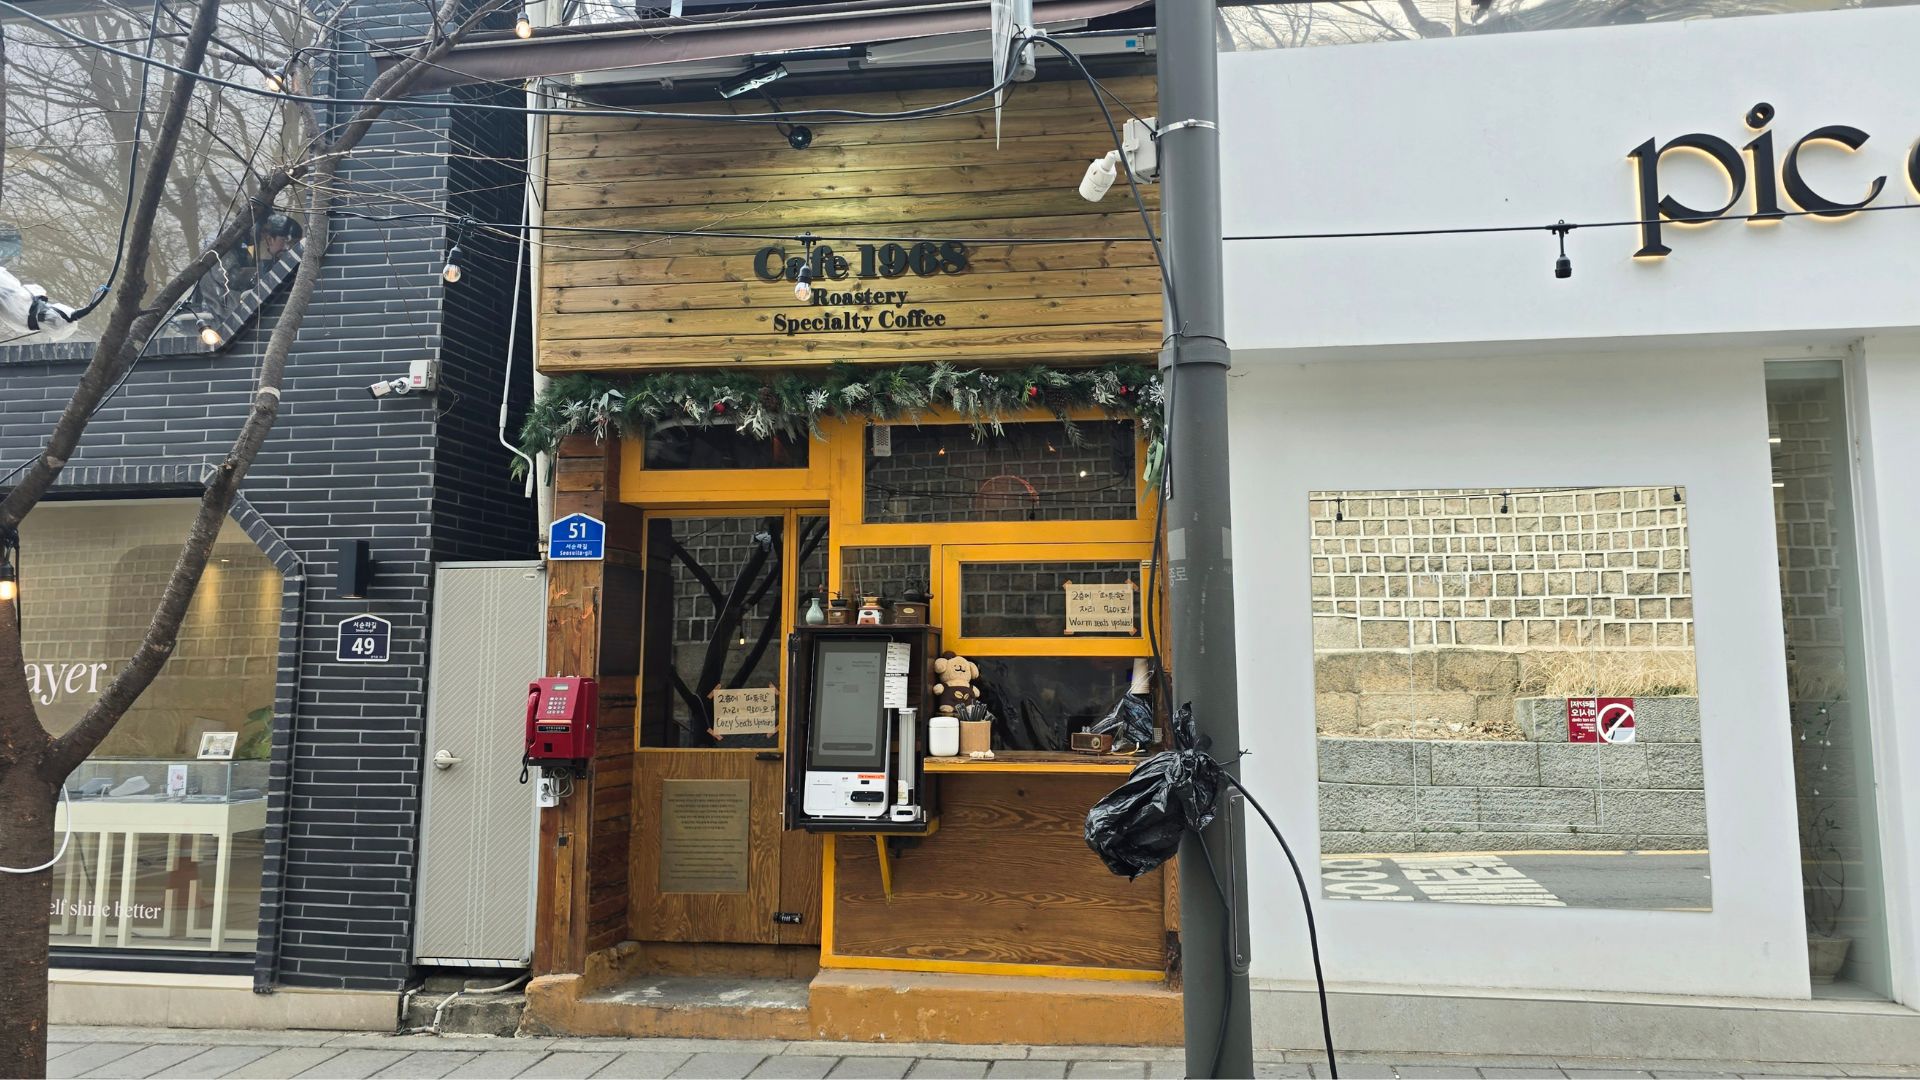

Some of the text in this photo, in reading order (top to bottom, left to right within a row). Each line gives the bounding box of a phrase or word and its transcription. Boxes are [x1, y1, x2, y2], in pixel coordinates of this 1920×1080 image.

[1627, 102, 1920, 257] pic
[754, 241, 968, 281] Cafe 1968
[811, 288, 909, 308] Roastery
[773, 309, 946, 335] Specialty Coffee
[568, 522, 587, 539] 51
[353, 621, 377, 629] 서순라길
[1069, 617, 1093, 626] Warm
[351, 637, 375, 655] 49
[24, 662, 108, 706] ayer
[716, 717, 734, 731] Cozy
[50, 898, 67, 915] elf
